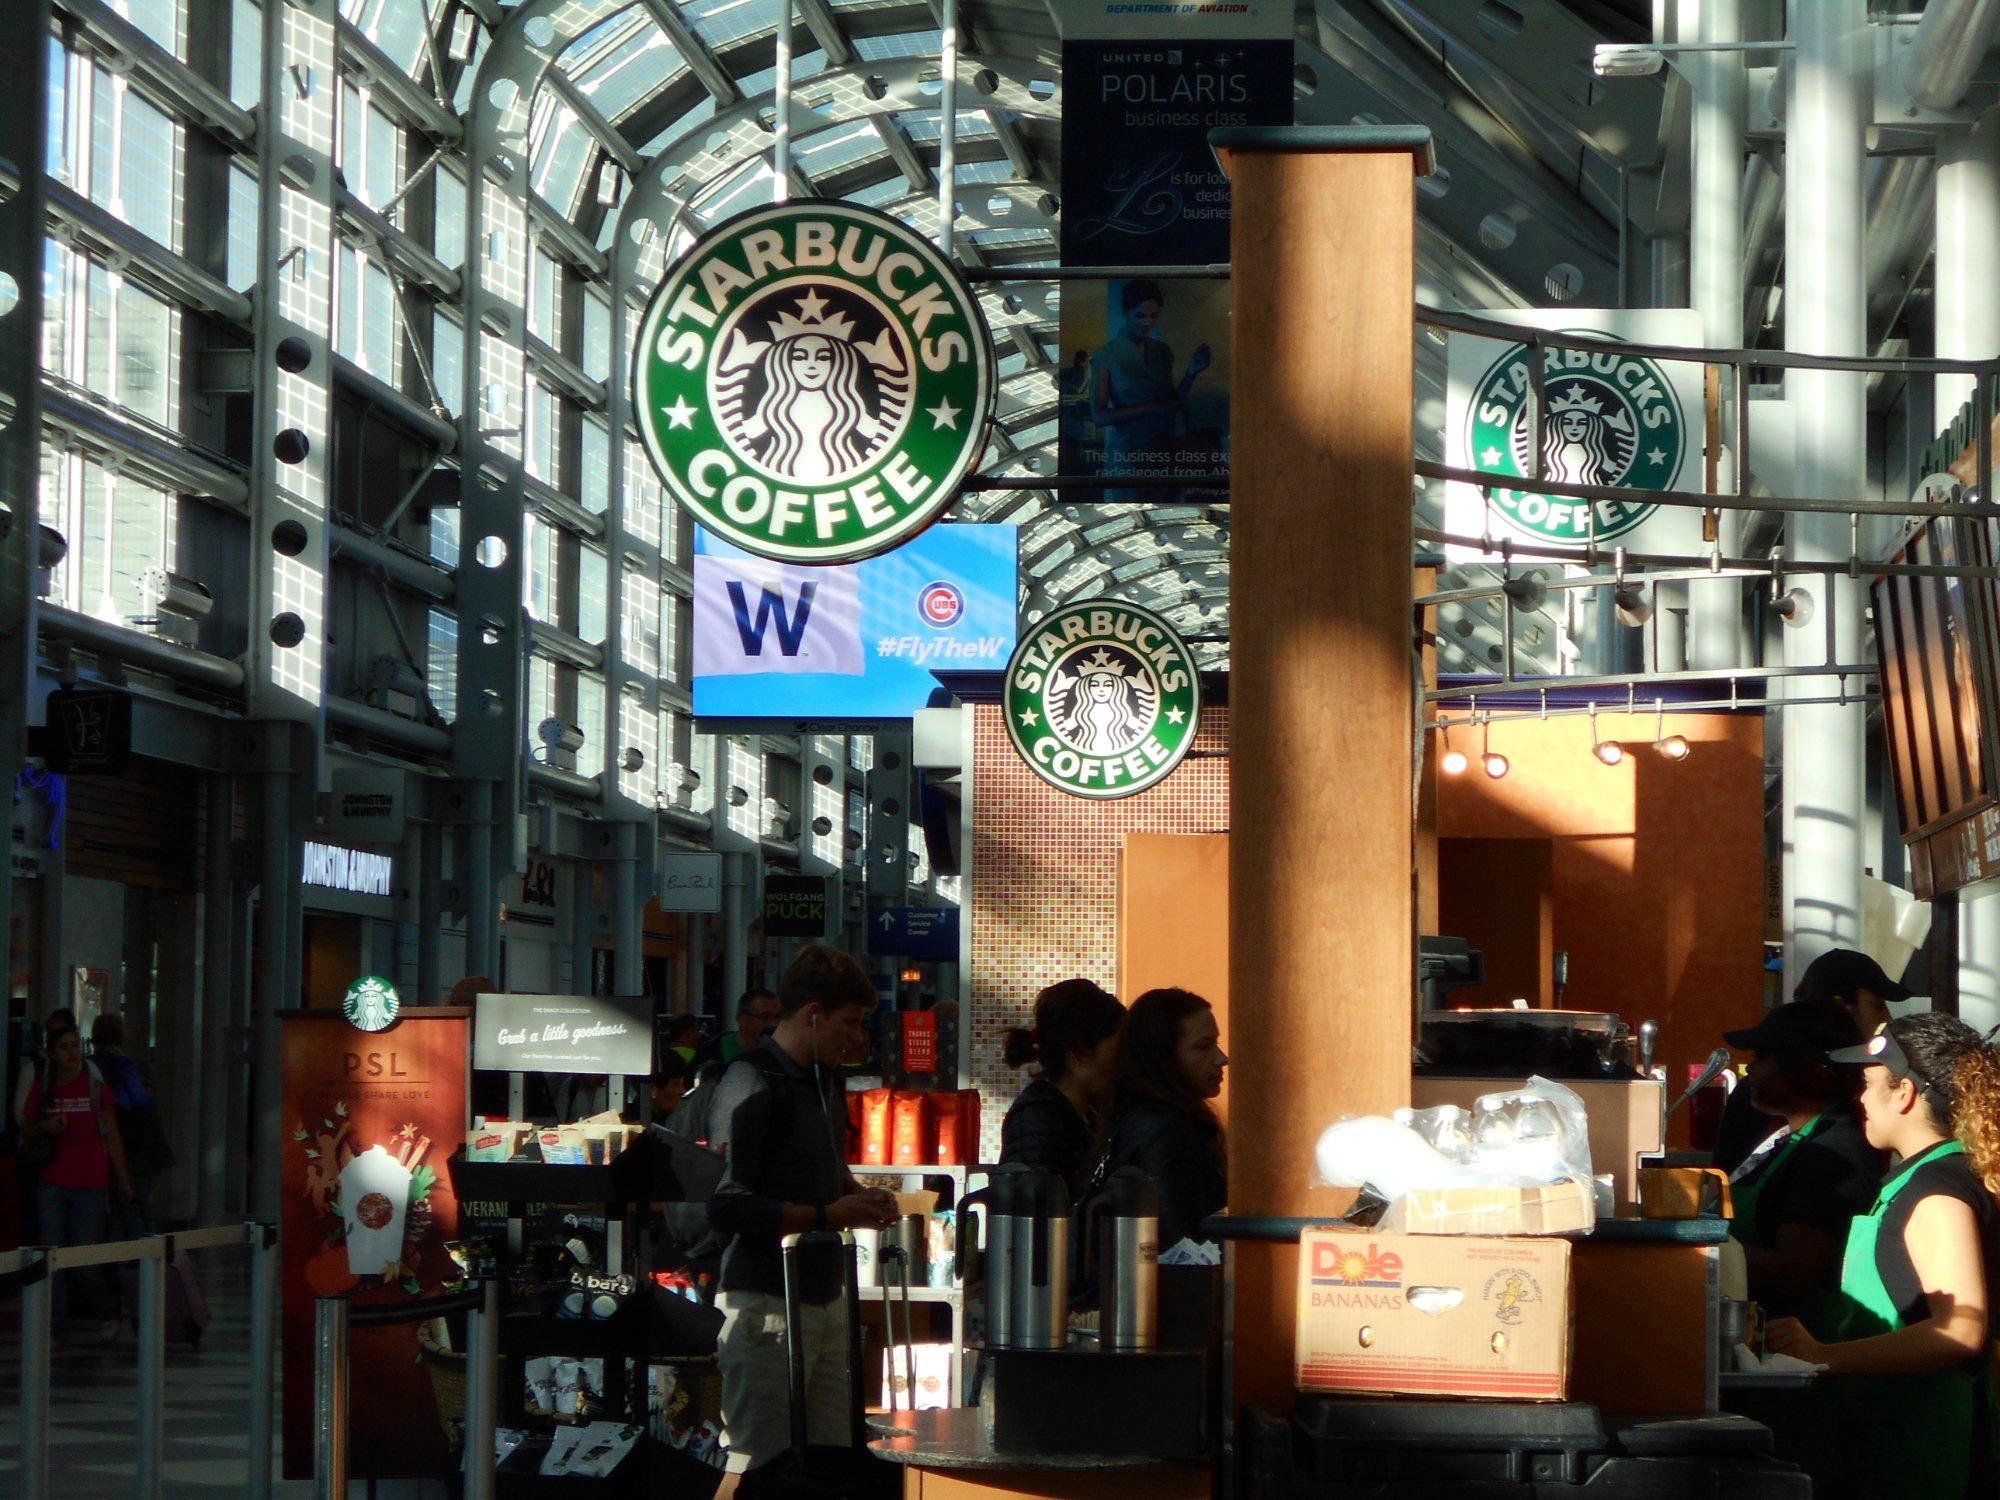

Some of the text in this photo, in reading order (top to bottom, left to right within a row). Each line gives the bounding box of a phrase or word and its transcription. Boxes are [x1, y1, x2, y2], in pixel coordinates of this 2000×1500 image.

[1106, 4, 1248, 13] DEPARTMENT OF AVIATION
[1103, 53, 1164, 63] UNITED
[1102, 74, 1247, 103] POLARIS
[1125, 110, 1247, 126] business class
[1170, 172, 1232, 185] is for lou
[1196, 188, 1232, 203] dedic
[1183, 207, 1232, 220] busines
[657, 221, 968, 372] STARBUCKS
[1479, 346, 1671, 429] STARBUCKS
[1084, 450, 1231, 464] The business class ex
[1096, 467, 1231, 478] redesigned from Ab
[688, 450, 933, 539] COFFEE
[726, 580, 818, 657] W
[877, 636, 1005, 666] #FlyTheW
[1015, 610, 1189, 694] STARBUCKS
[809, 722, 836, 732] Clear
[839, 722, 880, 732] Channel
[1033, 735, 1170, 786] COFFEE
[343, 794, 393, 805] JOHNSTON
[766, 892, 824, 902] WOLFGANG
[766, 903, 824, 920] PUCK
[907, 911, 938, 919] Customer
[497, 1020, 628, 1046] Grab a little goodness.
[343, 1052, 407, 1077] PSL
[365, 1090, 400, 1099] SHARE
[402, 1090, 431, 1099] LOVE
[1312, 1241, 1404, 1281] Dole
[1311, 1291, 1402, 1310] BANANAS
